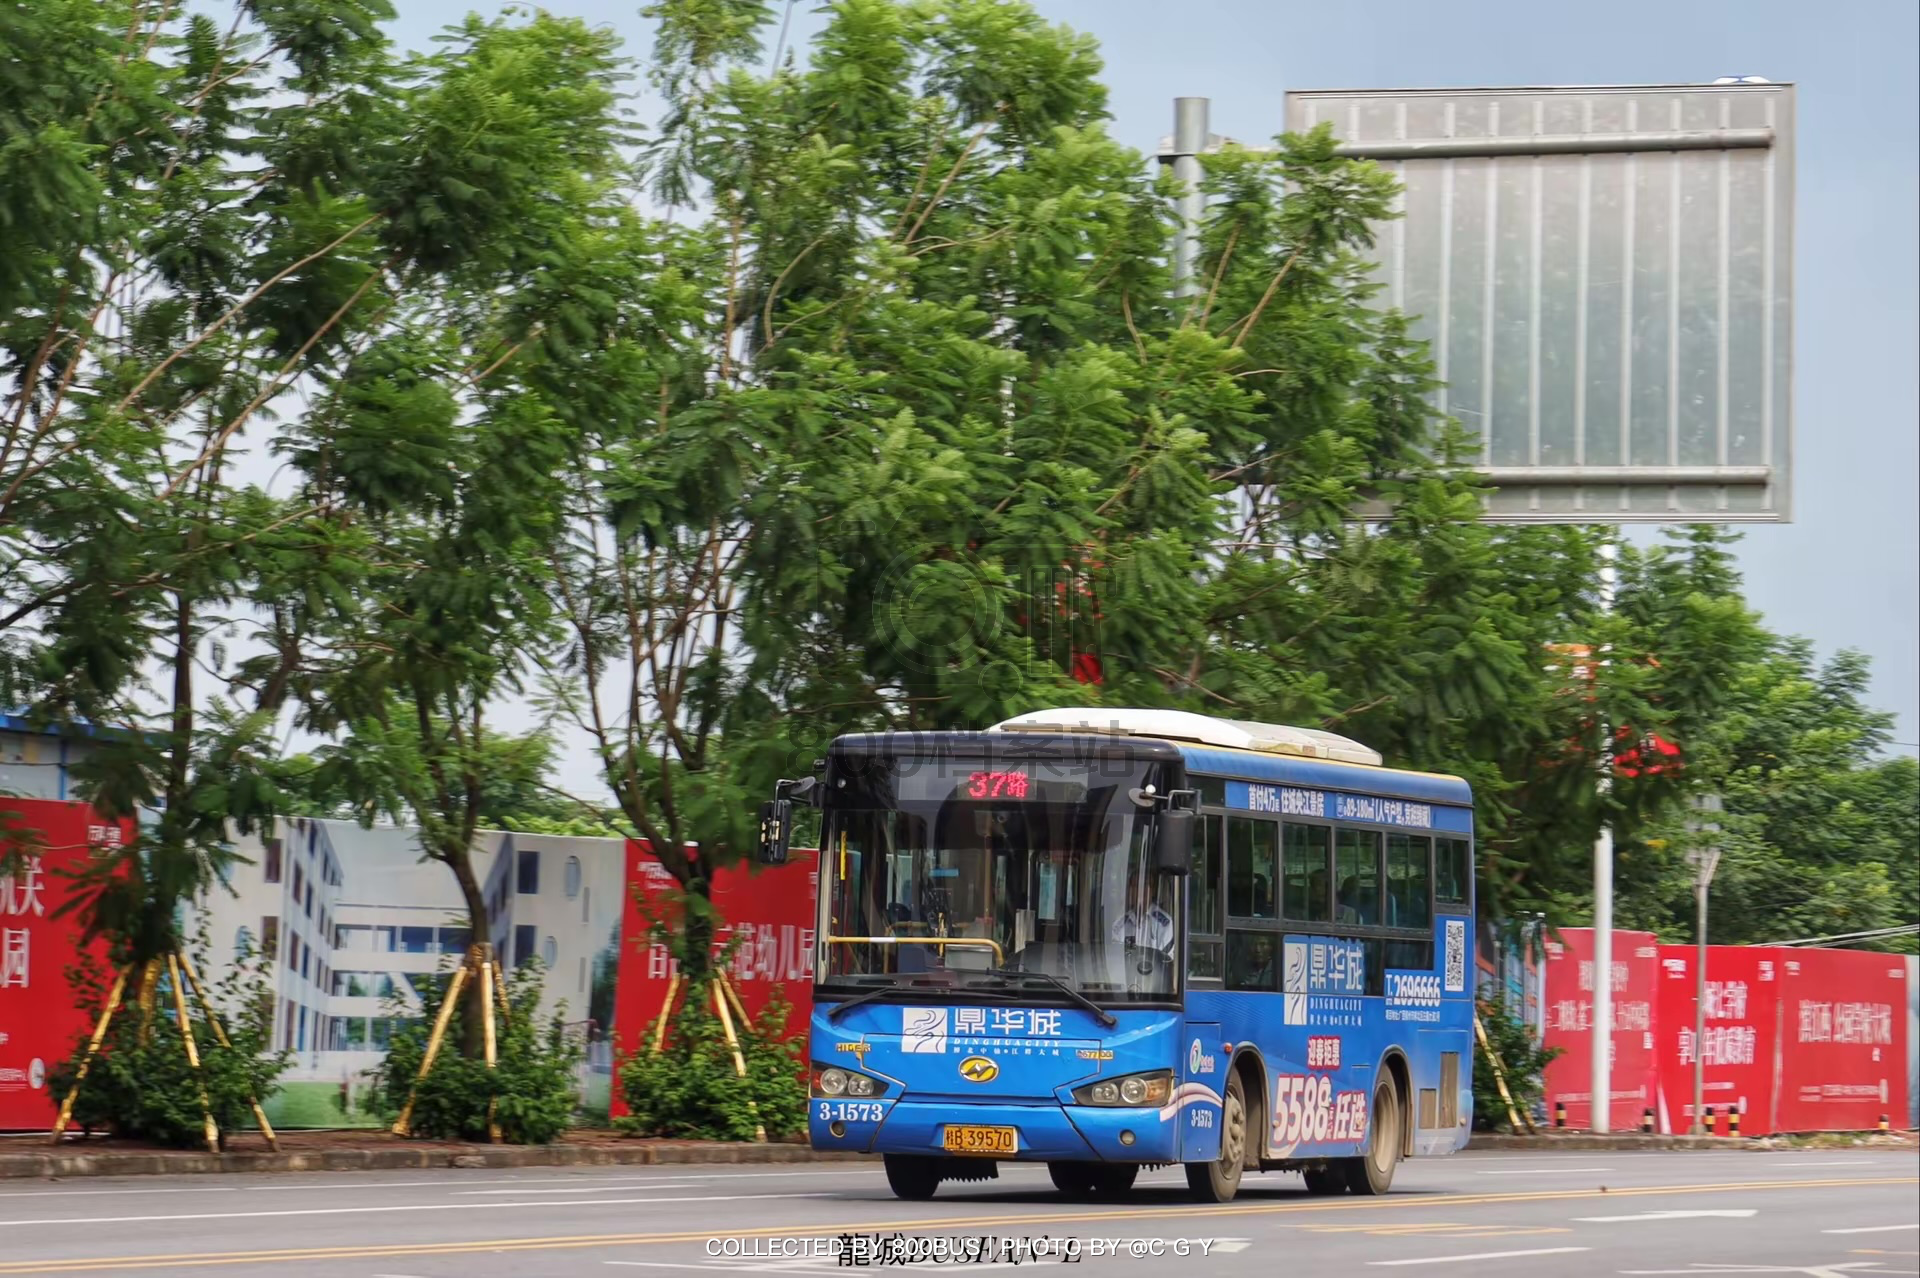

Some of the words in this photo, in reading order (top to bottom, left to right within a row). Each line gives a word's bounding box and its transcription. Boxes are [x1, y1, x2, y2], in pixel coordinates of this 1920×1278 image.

[968, 772, 1029, 798] 37路
[1310, 943, 1362, 990] 鼎华城
[1393, 975, 1441, 1007] 2696666
[954, 1008, 1061, 1035] 鼎华城
[836, 1043, 872, 1052] HIGER
[953, 1038, 1060, 1047] DINGHUACITY
[819, 1102, 883, 1122] 3-1573
[1190, 1108, 1213, 1129] 3-1573
[1273, 1076, 1331, 1142] 5588
